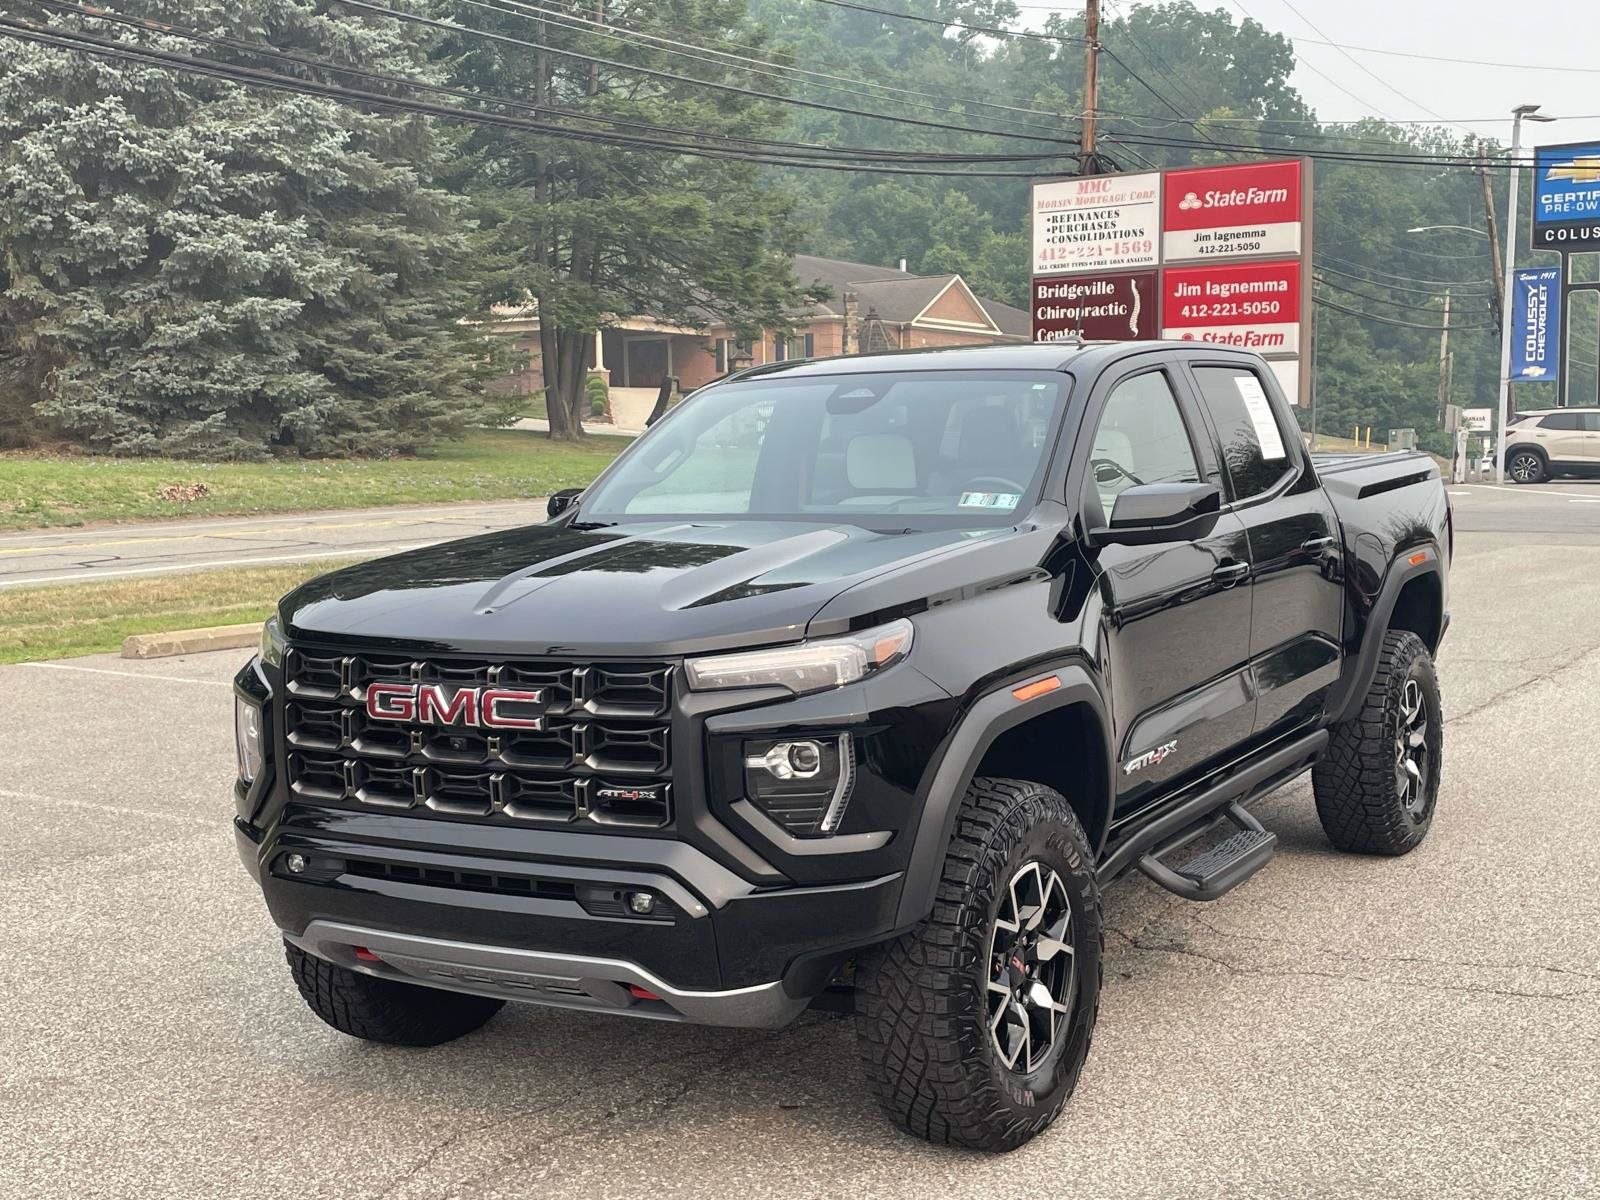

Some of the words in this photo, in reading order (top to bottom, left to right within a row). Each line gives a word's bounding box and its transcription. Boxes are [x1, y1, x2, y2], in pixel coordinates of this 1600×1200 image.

[1077, 180, 1112, 194] MMC
[1052, 209, 1120, 224] REFINANCES
[1052, 220, 1117, 234] PURCHASES
[1052, 228, 1145, 244] CONSOLIDATIONS
[1194, 233, 1211, 242] Jim
[1039, 240, 1153, 260] 412-221-1569
[1199, 242, 1260, 254] 412-221-5050
[1038, 281, 1115, 300] Bridgeville
[1174, 282, 1201, 297] Jim
[1037, 302, 1128, 320] Chiropractic
[1182, 301, 1280, 317] 412-221-5050
[1526, 285, 1538, 362] COLUSSY
[1537, 284, 1547, 361] CHEVROLET
[367, 682, 544, 731] GMC
[1123, 739, 1178, 775] AT4X
[597, 789, 656, 800] AT4X
